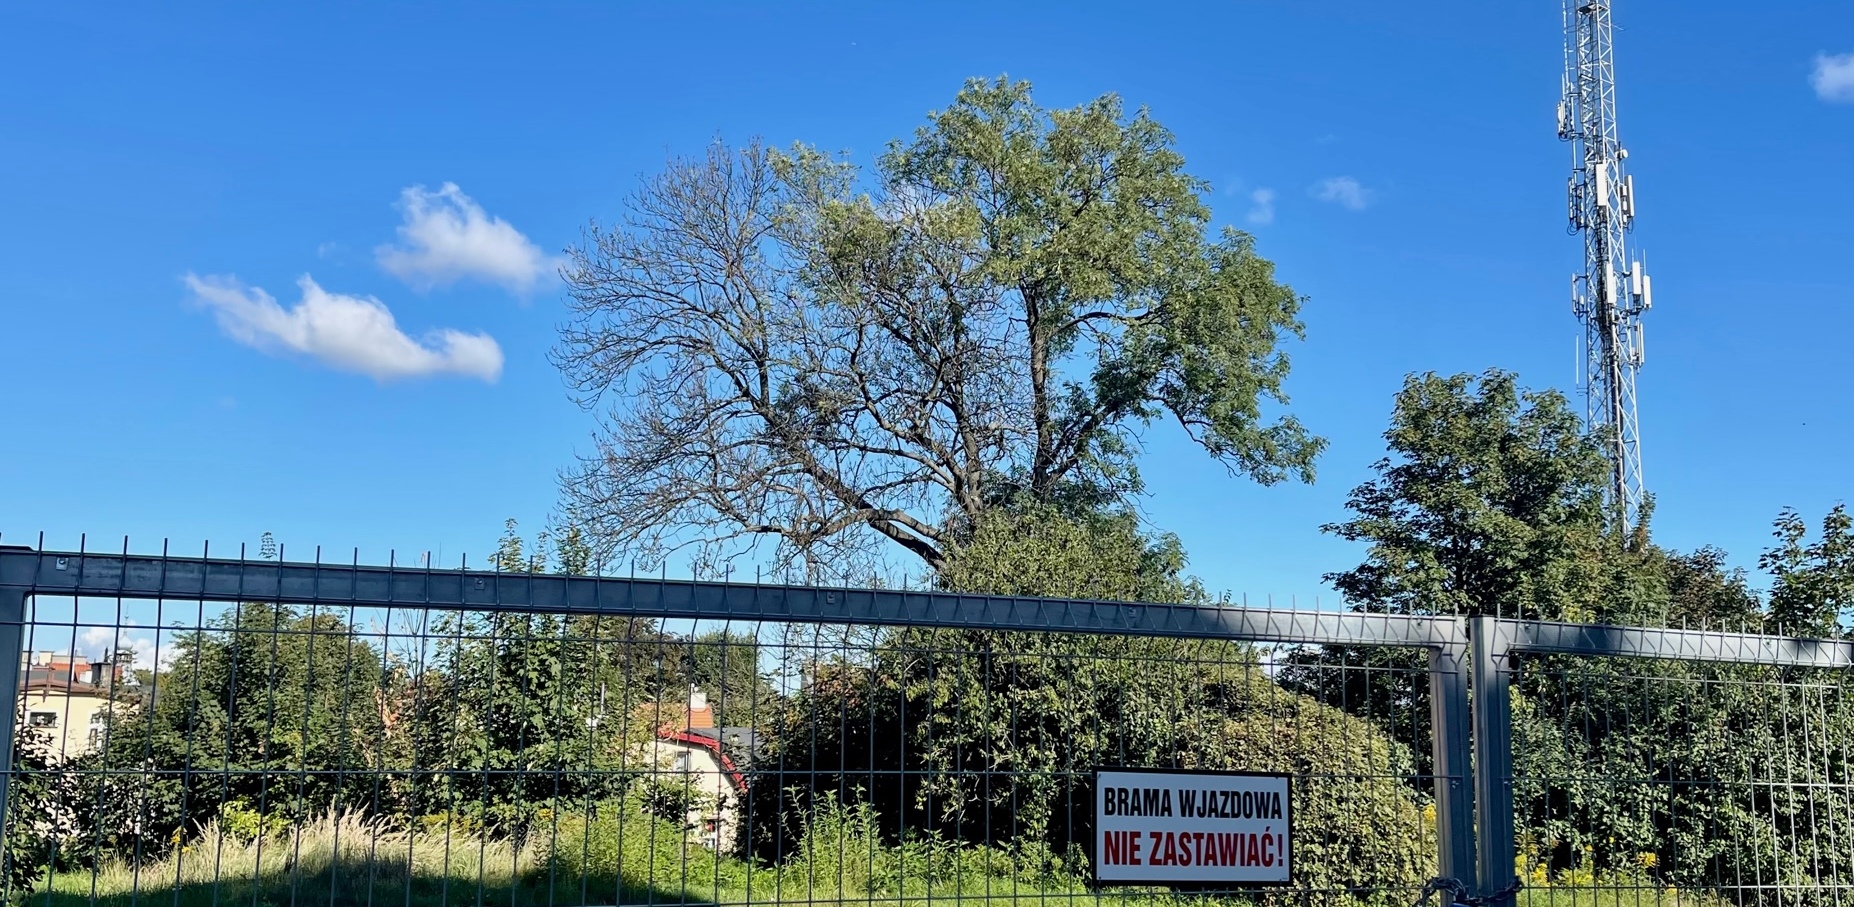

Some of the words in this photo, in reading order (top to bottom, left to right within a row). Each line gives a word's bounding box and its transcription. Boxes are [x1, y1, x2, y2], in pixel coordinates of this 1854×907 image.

[1104, 787, 1172, 817] BRAMA
[1178, 789, 1283, 819] WJAZDOWA
[1104, 831, 1141, 865] NIE
[1149, 826, 1283, 867] ZASTAWIAĆ!
